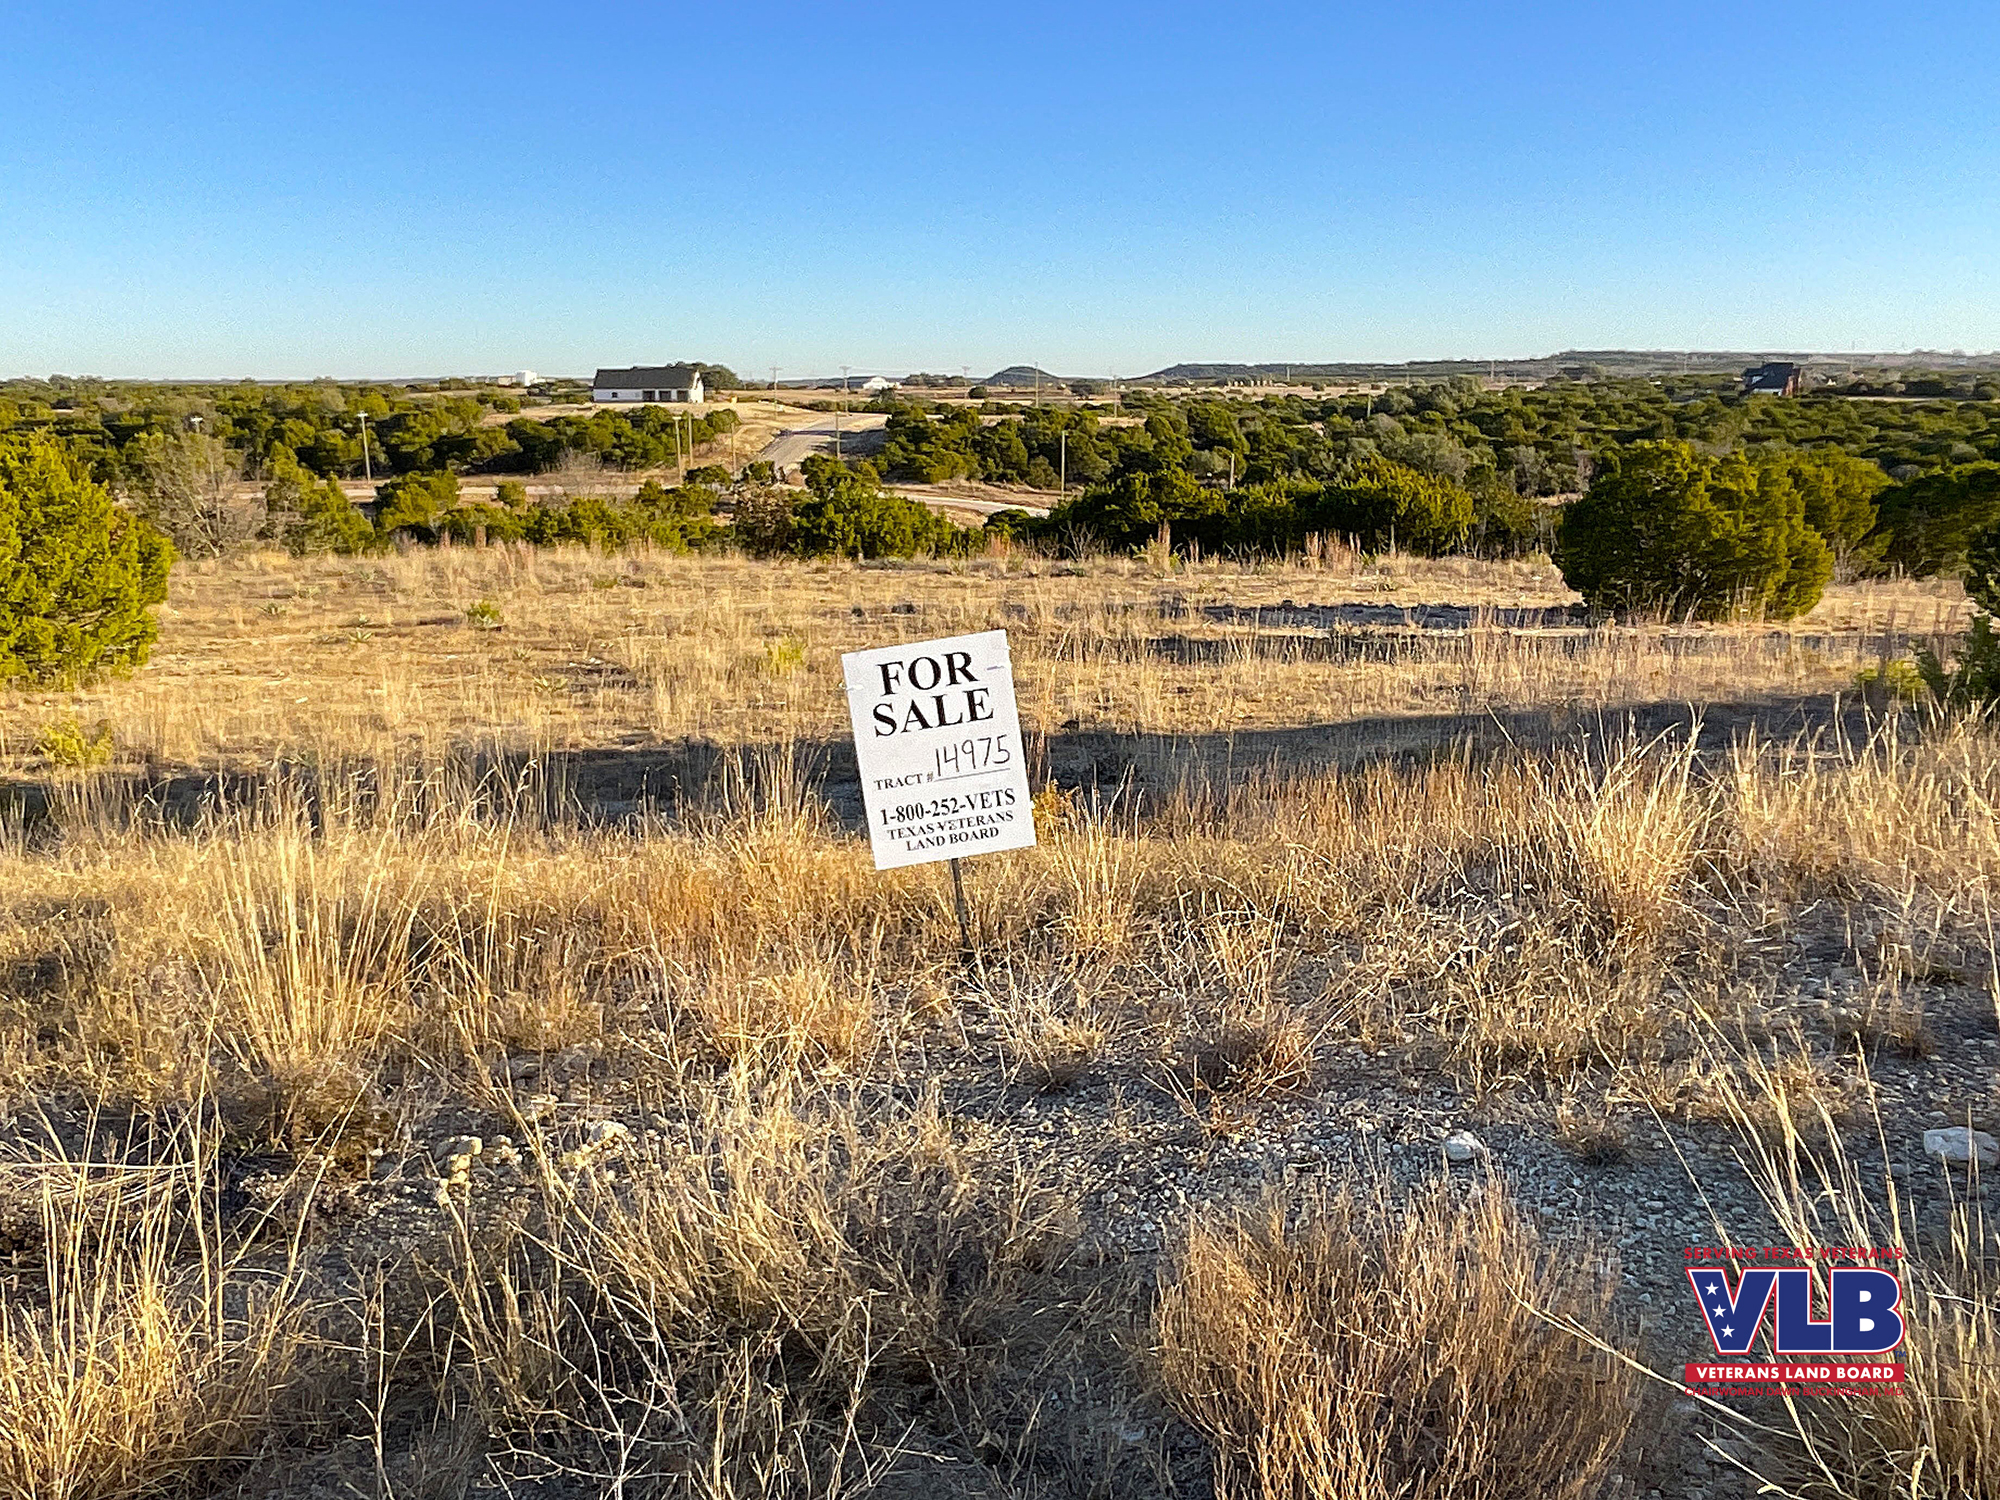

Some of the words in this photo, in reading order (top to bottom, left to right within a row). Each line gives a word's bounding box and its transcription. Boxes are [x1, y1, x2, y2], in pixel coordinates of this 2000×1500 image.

[875, 651, 980, 696] FOR
[872, 687, 994, 737] SALE
[935, 734, 1011, 777] 14975
[873, 773, 923, 791] TRACT
[926, 771, 935, 782] #
[880, 787, 1016, 826] 1-800-252-VETS
[887, 823, 935, 840] TEXAS
[937, 810, 1014, 832] VETERANS
[906, 835, 946, 851] LAND
[949, 826, 1000, 844] BOARD
